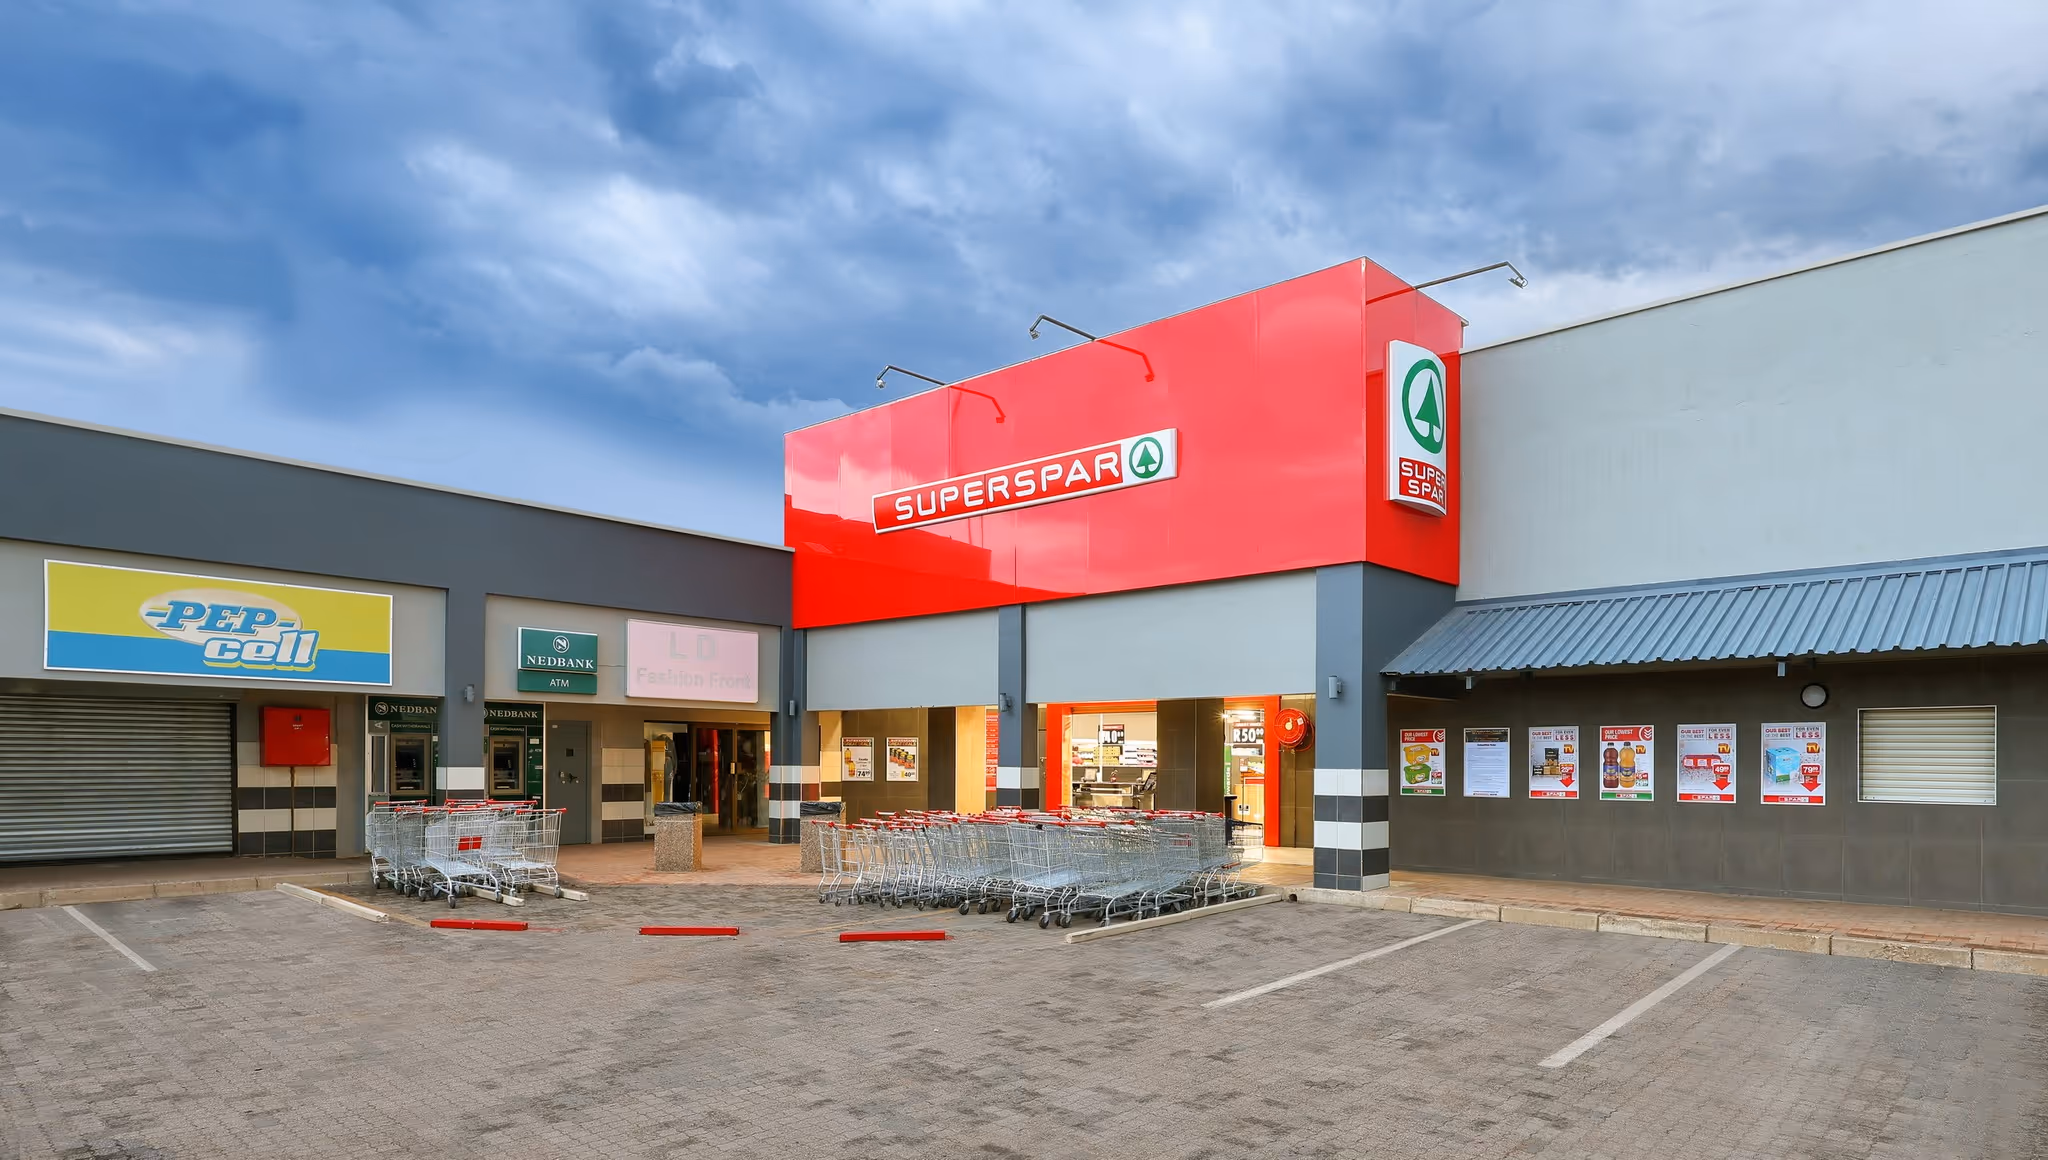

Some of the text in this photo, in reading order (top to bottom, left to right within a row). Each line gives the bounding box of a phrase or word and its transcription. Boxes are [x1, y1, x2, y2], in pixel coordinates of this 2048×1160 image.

[893, 451, 1120, 521] SUPERSPAR
[1401, 461, 1446, 490] SUPER
[1408, 480, 1444, 504] SPAR
[203, 631, 318, 667] cell
[526, 655, 594, 669] NEDBANK
[549, 678, 570, 688] ATM
[636, 667, 752, 689] Fashion Front
[390, 705, 438, 714] NEDBAN
[489, 709, 538, 719] NEDBANK
